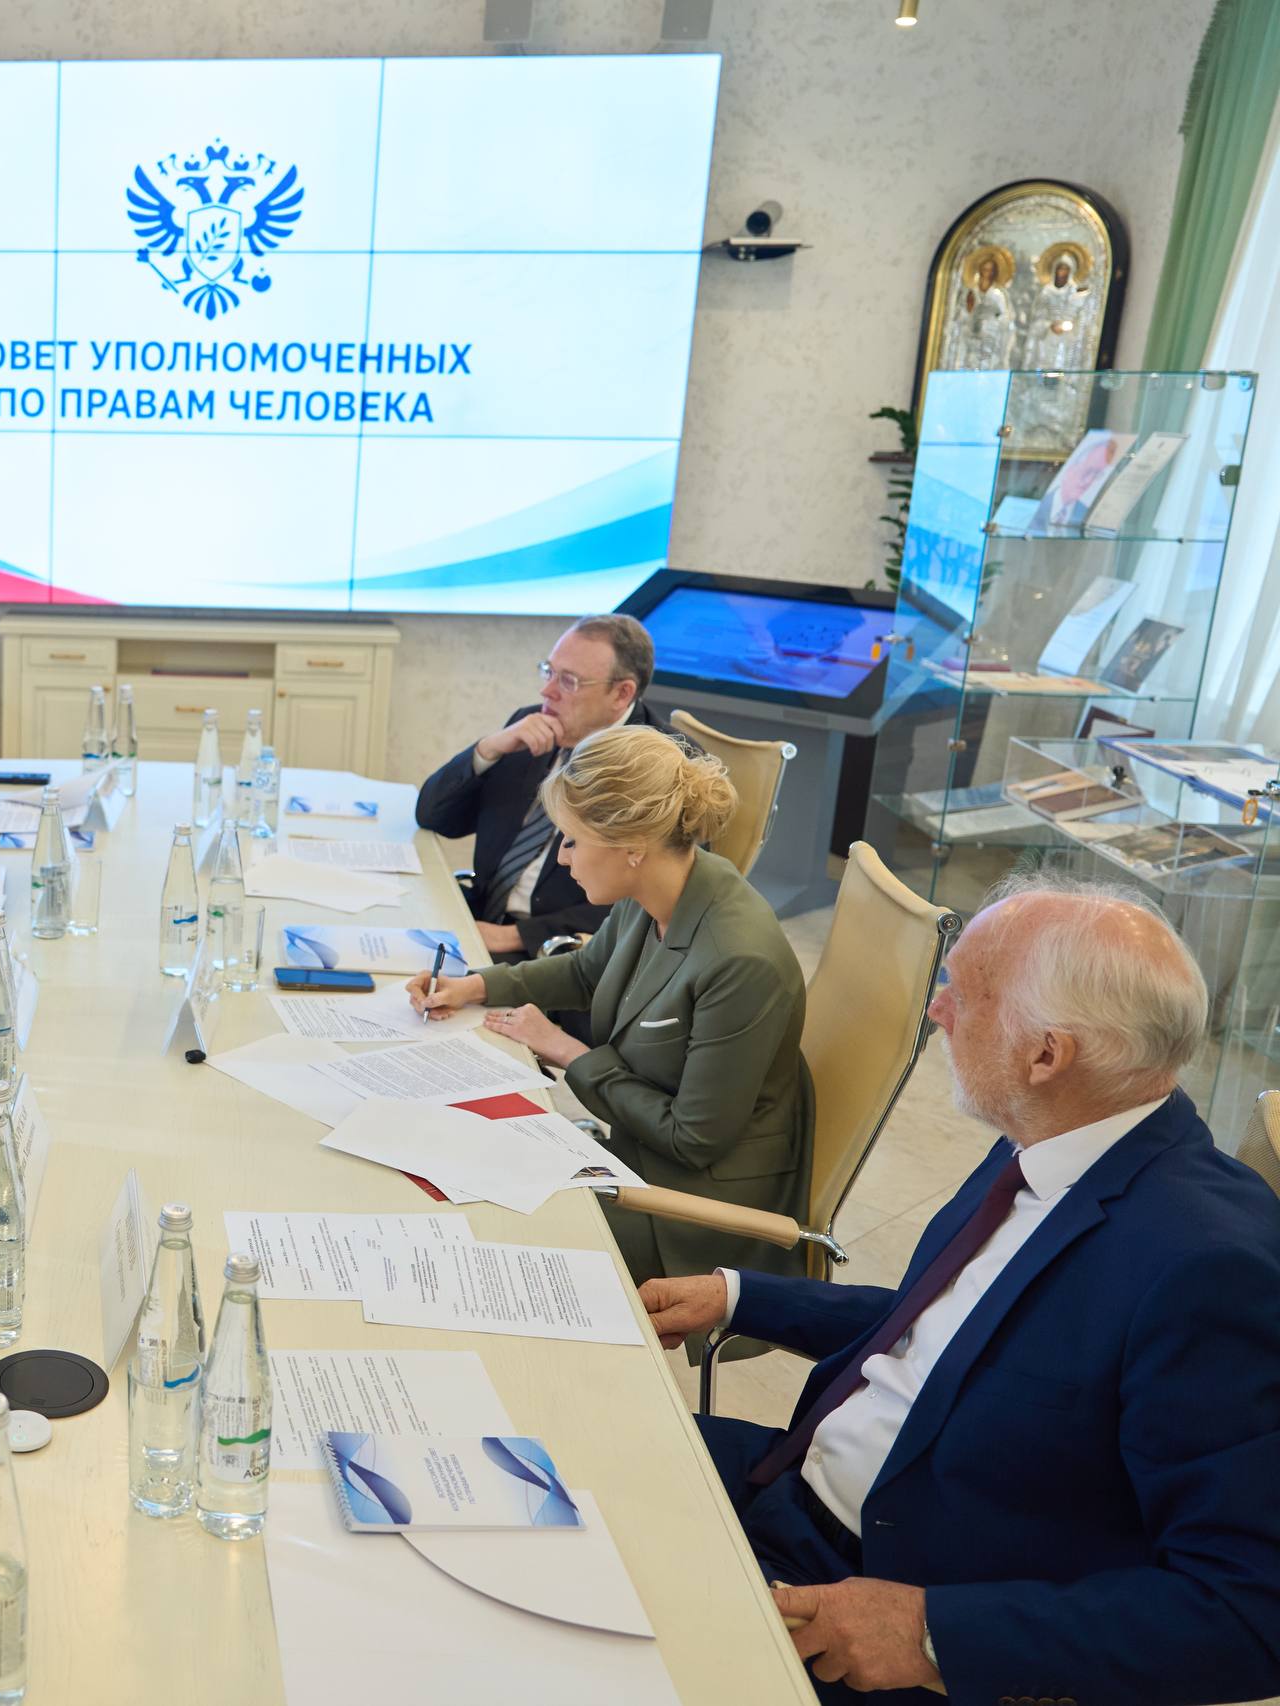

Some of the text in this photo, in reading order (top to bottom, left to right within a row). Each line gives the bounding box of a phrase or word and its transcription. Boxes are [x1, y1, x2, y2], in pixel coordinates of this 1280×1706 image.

[90, 341, 472, 374] УПОЛНОМОЧЕННЫХ
[61, 388, 215, 419] ПРАВАМ
[229, 390, 433, 423] ЧЕЛОВЕКА
